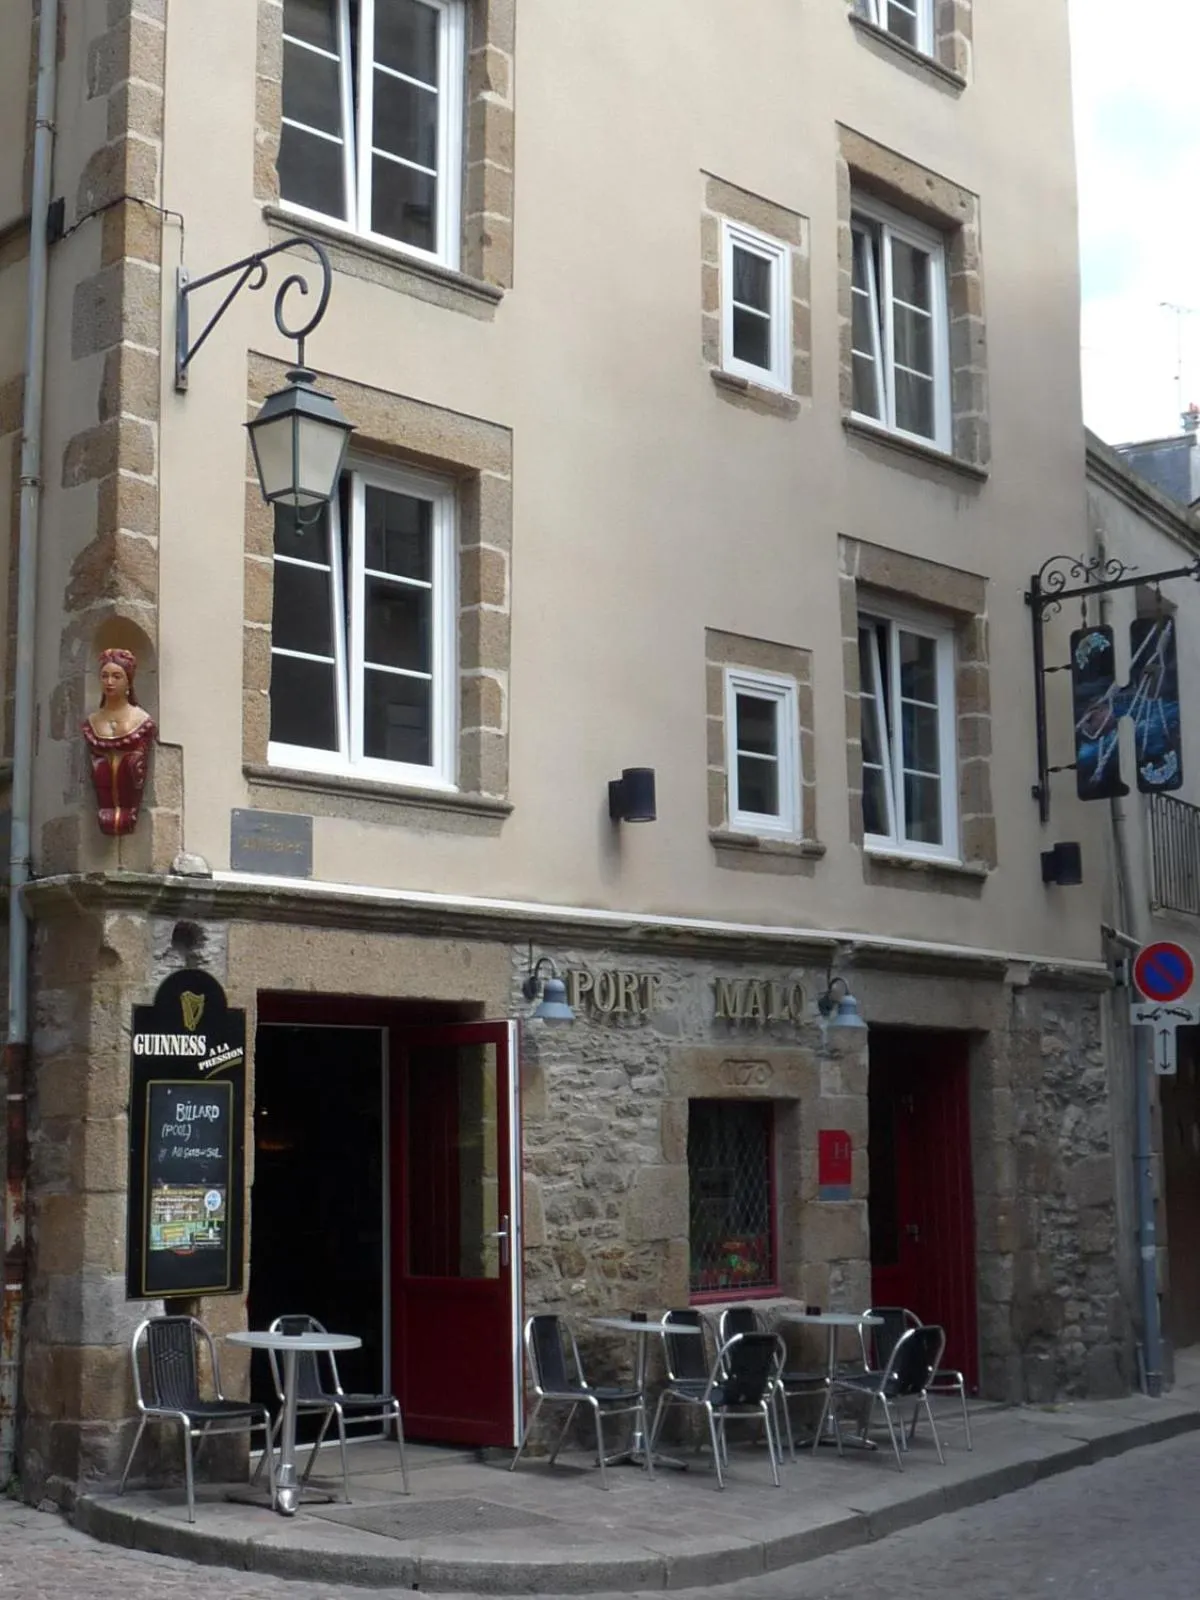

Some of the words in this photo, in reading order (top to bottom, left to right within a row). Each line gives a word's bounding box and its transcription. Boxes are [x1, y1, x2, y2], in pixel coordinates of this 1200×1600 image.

[571, 970, 660, 1013] PORT
[714, 976, 807, 1020] MALO
[133, 1033, 207, 1056] GUINNESS
[218, 1042, 230, 1054] LA
[198, 1046, 244, 1071] PRESSION
